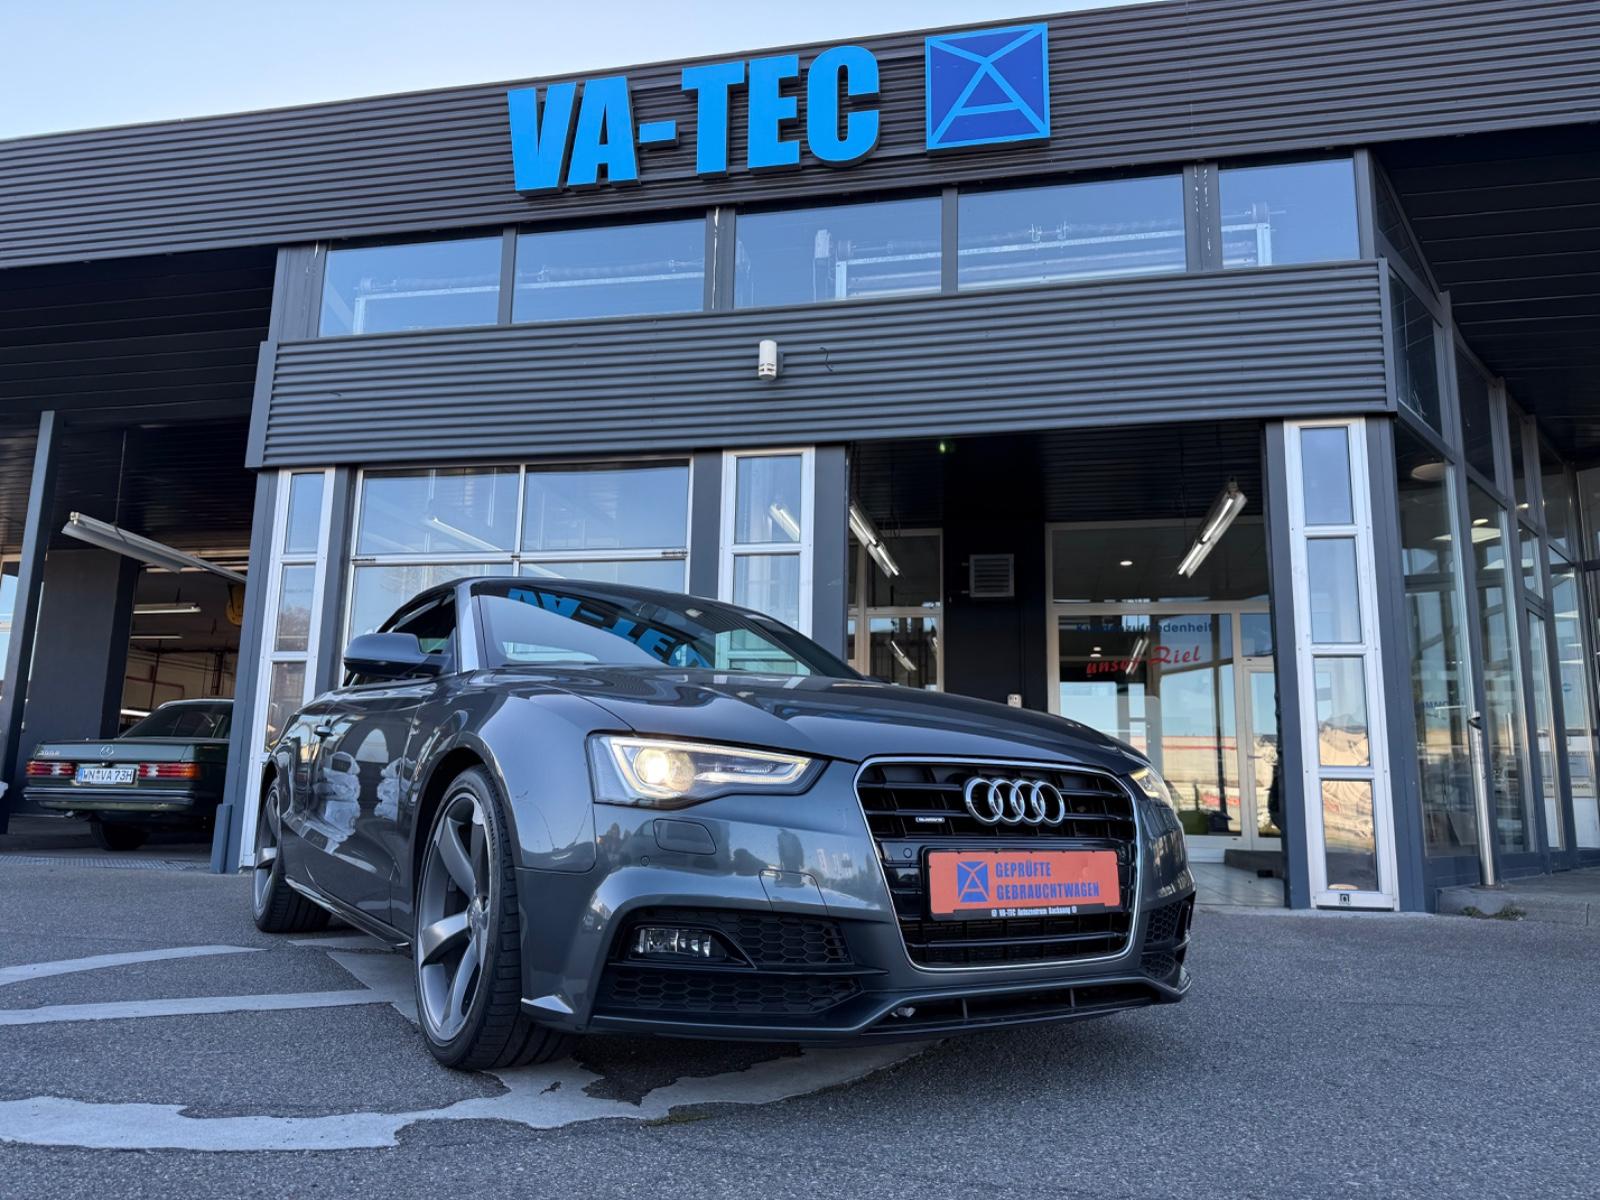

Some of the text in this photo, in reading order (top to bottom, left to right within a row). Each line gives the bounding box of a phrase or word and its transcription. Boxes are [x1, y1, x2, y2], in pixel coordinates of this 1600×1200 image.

[507, 45, 880, 193] VA-TEC
[1076, 622, 1214, 633] Kudenzufredenheit
[1149, 645, 1201, 665] Ziel
[82, 770, 95, 780] WN
[101, 770, 112, 781] VA
[995, 860, 1051, 878] GEPRÜFTE
[996, 882, 1099, 901] GEBRAUCHTWAGEN
